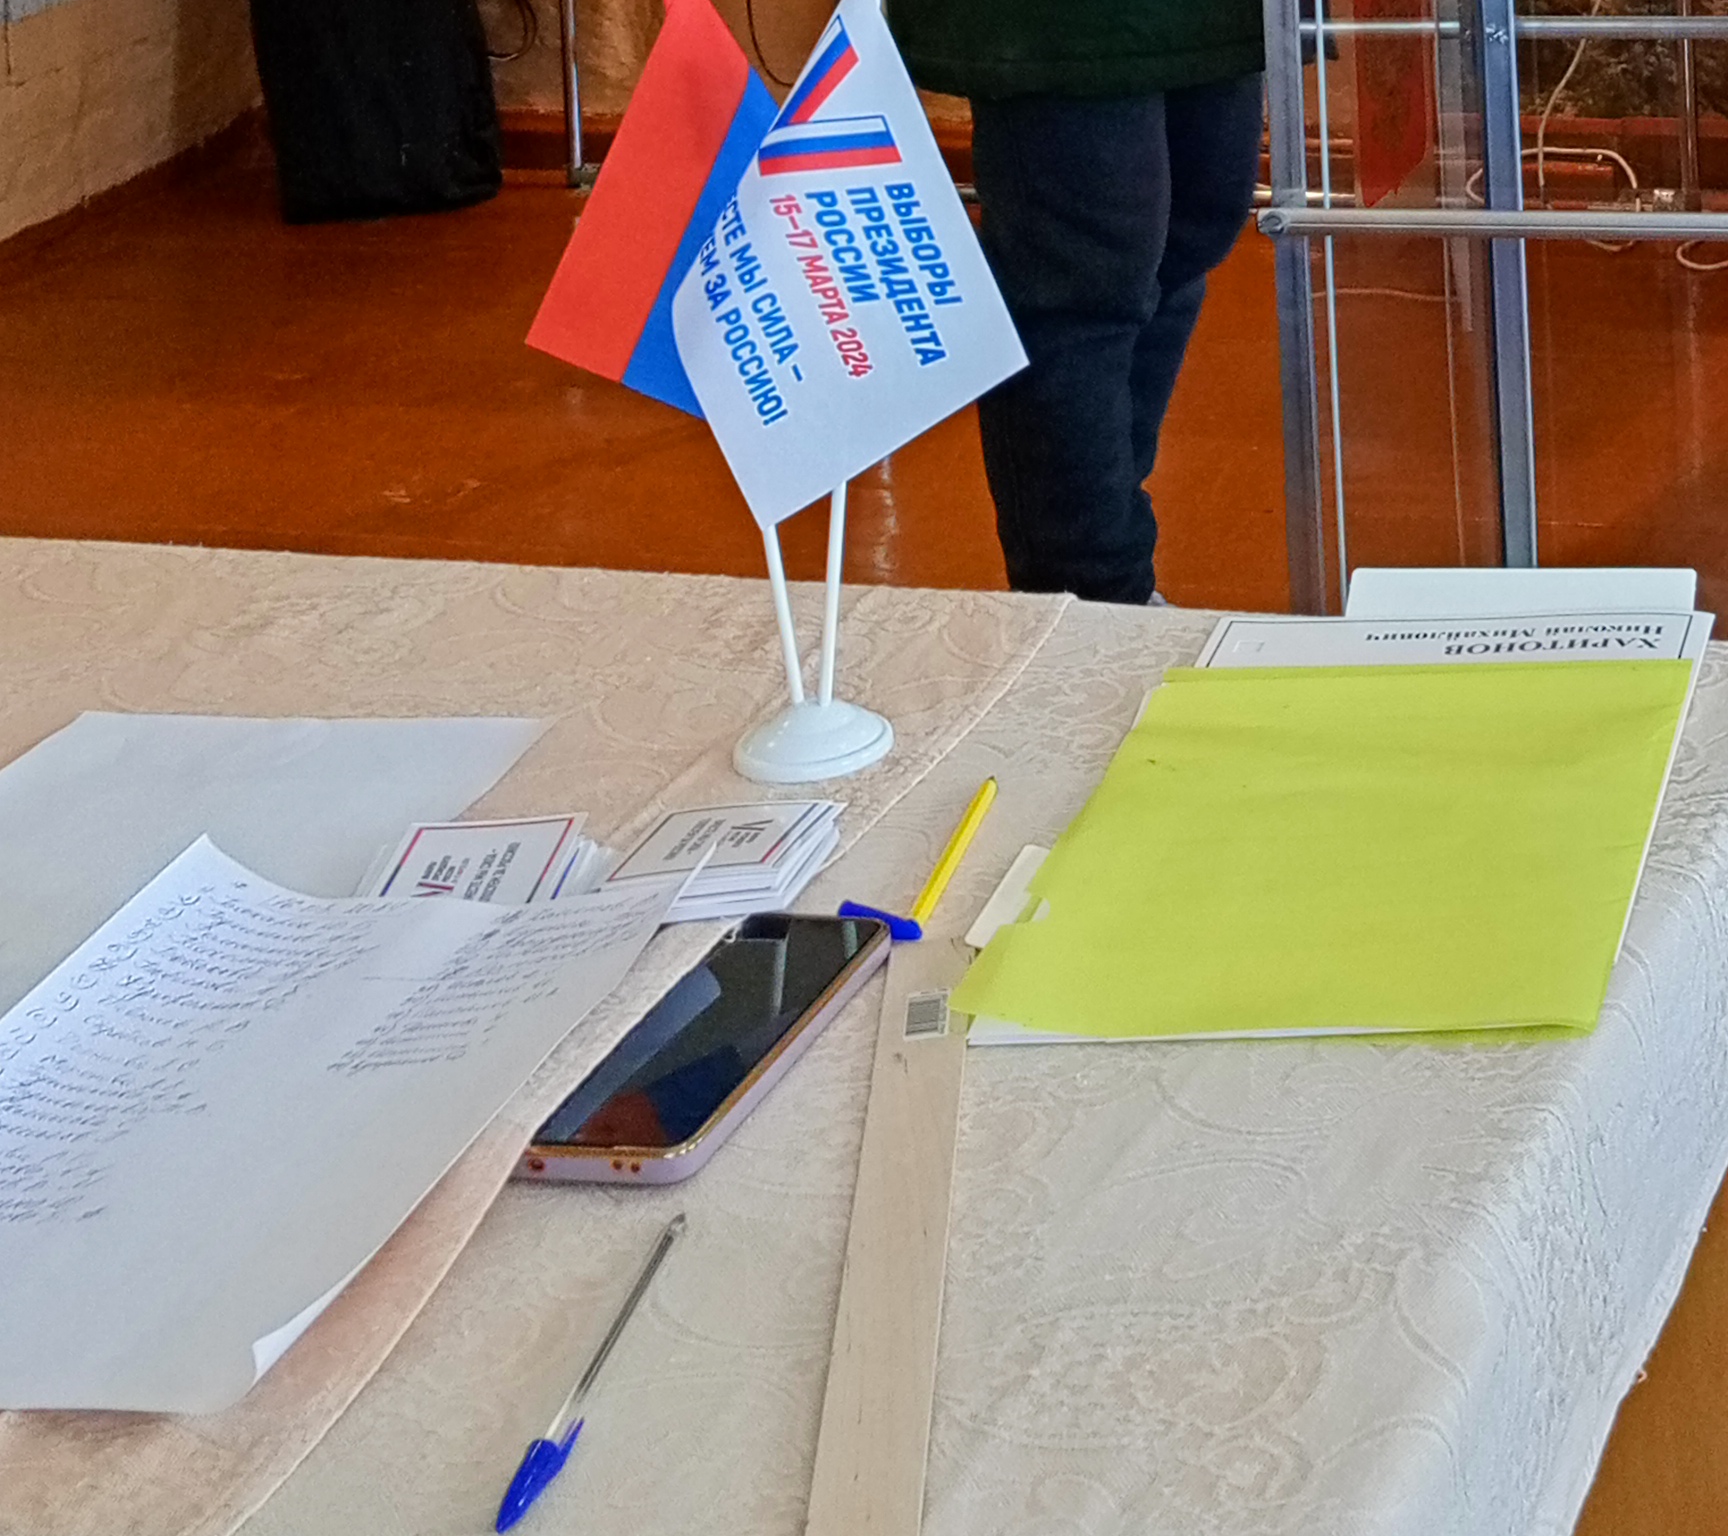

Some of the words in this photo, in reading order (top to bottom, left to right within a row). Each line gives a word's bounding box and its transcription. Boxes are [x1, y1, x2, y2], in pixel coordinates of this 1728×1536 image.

[704, 274, 732, 311] ЗА
[805, 190, 881, 303] РОССИИ
[846, 186, 947, 366] ПРЕЗИДЕНТА
[884, 182, 963, 306] ВЫБОРЫ
[728, 243, 768, 293] МЫ
[752, 292, 799, 365] СИЛА
[797, 254, 851, 325] МАРТА
[830, 327, 874, 378] 2024
[715, 306, 788, 426] РОССИЮ!
[1365, 627, 1536, 641] Михайлович
[1445, 637, 1661, 656] ХАРИТОНОВ
[1546, 625, 1664, 637] Николай
